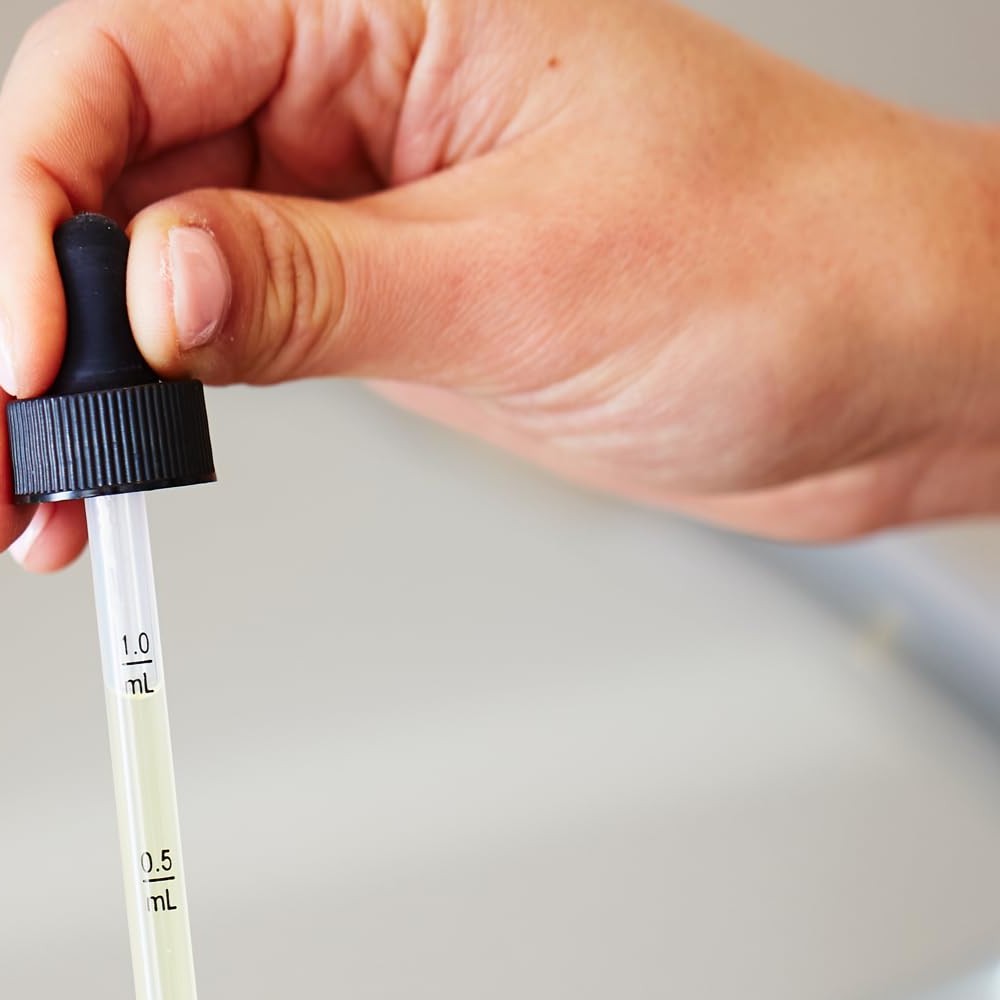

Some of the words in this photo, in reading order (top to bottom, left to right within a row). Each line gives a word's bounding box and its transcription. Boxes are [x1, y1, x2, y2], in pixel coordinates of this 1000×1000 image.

[121, 632, 150, 656] 1.0
[125, 672, 154, 694] mL
[141, 849, 173, 873] 0.5
[146, 889, 177, 912] mL
